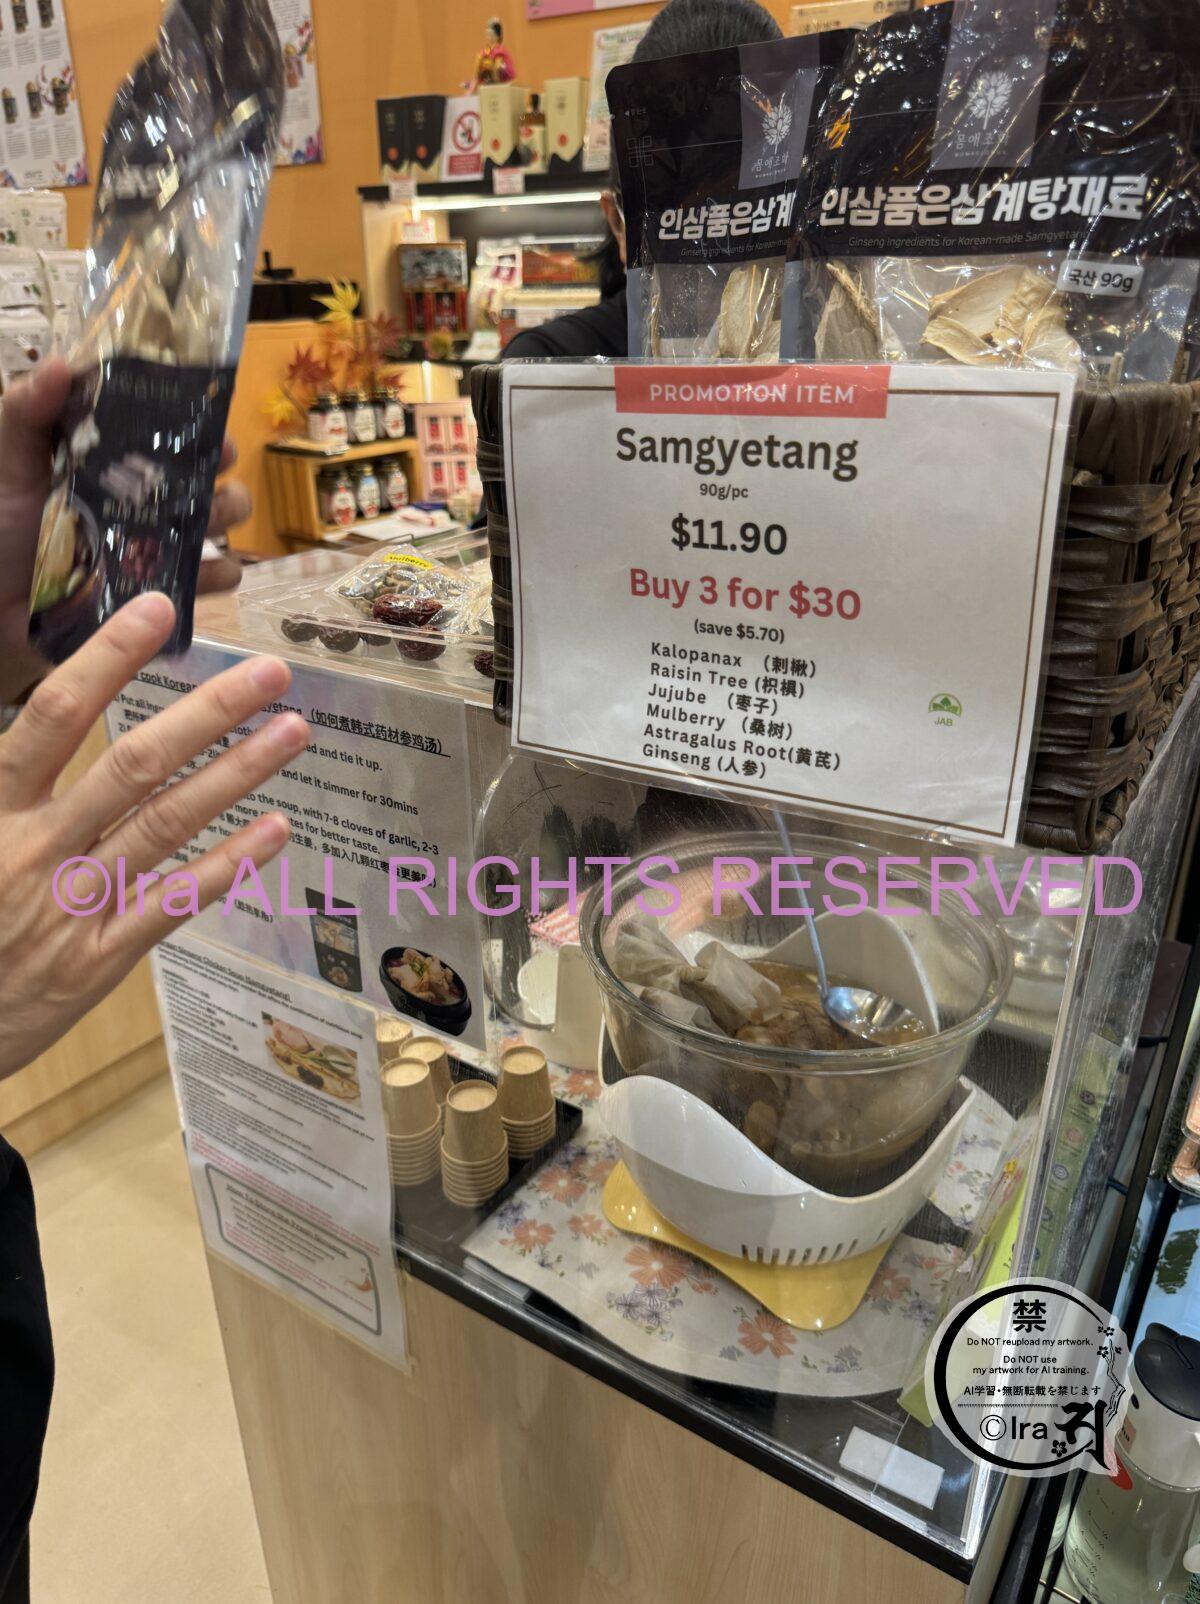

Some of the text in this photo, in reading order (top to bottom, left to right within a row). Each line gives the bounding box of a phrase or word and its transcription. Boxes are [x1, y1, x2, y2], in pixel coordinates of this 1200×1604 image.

[819, 175, 1150, 228] 인삼품은삼계탕재료
[848, 236, 885, 249] Ginseng
[957, 231, 1023, 247] Korean-made
[1068, 268, 1135, 293] 국산 90g
[650, 383, 855, 404] PROMOTION ITEM
[616, 427, 859, 482] Samgyetang
[700, 483, 749, 501] 90g/pc
[671, 512, 787, 555] $11.90
[630, 568, 861, 620] Buy 3 for $30
[694, 619, 785, 645] (save $5.70)
[651, 641, 742, 668] Kalopanax
[140, 671, 162, 687] cook
[650, 662, 701, 682] Raisin
[709, 670, 748, 689] Tree
[648, 683, 707, 704] Jujube
[646, 703, 726, 732] Mulberry
[934, 716, 953, 727] JAB
[643, 723, 737, 751] Astragalus
[319, 746, 338, 760] and
[340, 752, 354, 764] tie
[355, 755, 364, 765] it
[365, 759, 383, 773] up.
[642, 743, 711, 771] Ginseng
[281, 769, 420, 816] and let it simmer for 30mins
[234, 803, 382, 855] more tes for better taste.
[257, 794, 276, 806] the
[276, 799, 302, 815] soup,
[302, 807, 323, 822] with
[341, 820, 374, 837] cloves
[375, 829, 387, 840] of
[388, 833, 421, 852] garlic,
[421, 841, 440, 856] 2-3
